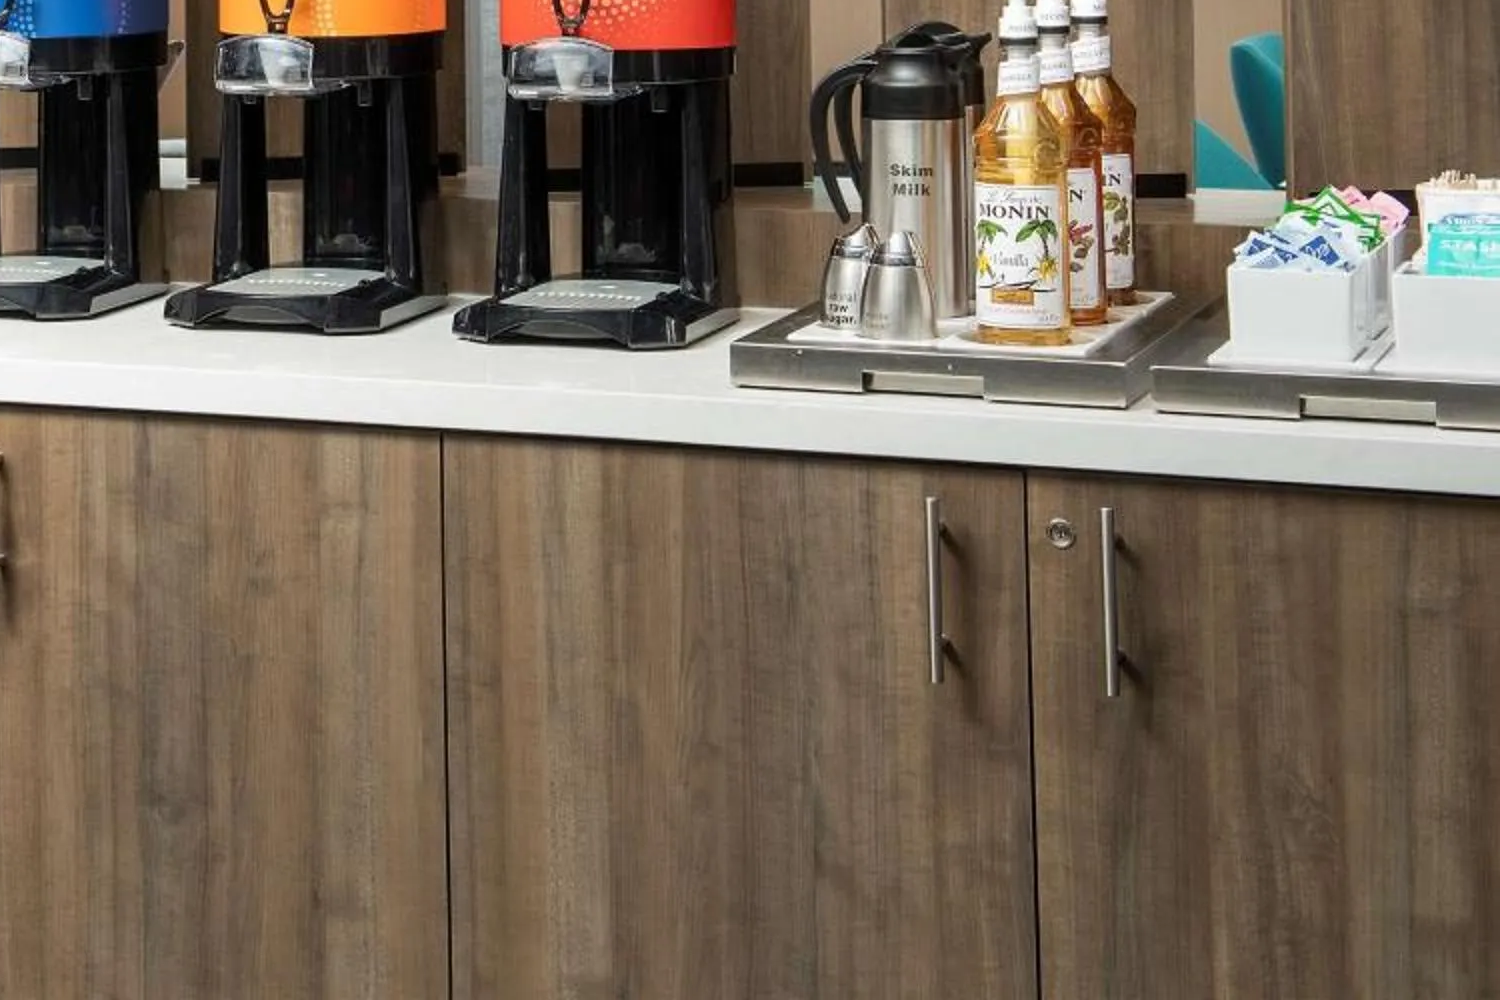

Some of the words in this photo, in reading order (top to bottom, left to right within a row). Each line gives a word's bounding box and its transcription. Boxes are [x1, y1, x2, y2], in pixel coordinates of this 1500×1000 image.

[889, 162, 934, 177] Skim
[892, 183, 931, 197] Milk
[978, 204, 1050, 219] MONIN
